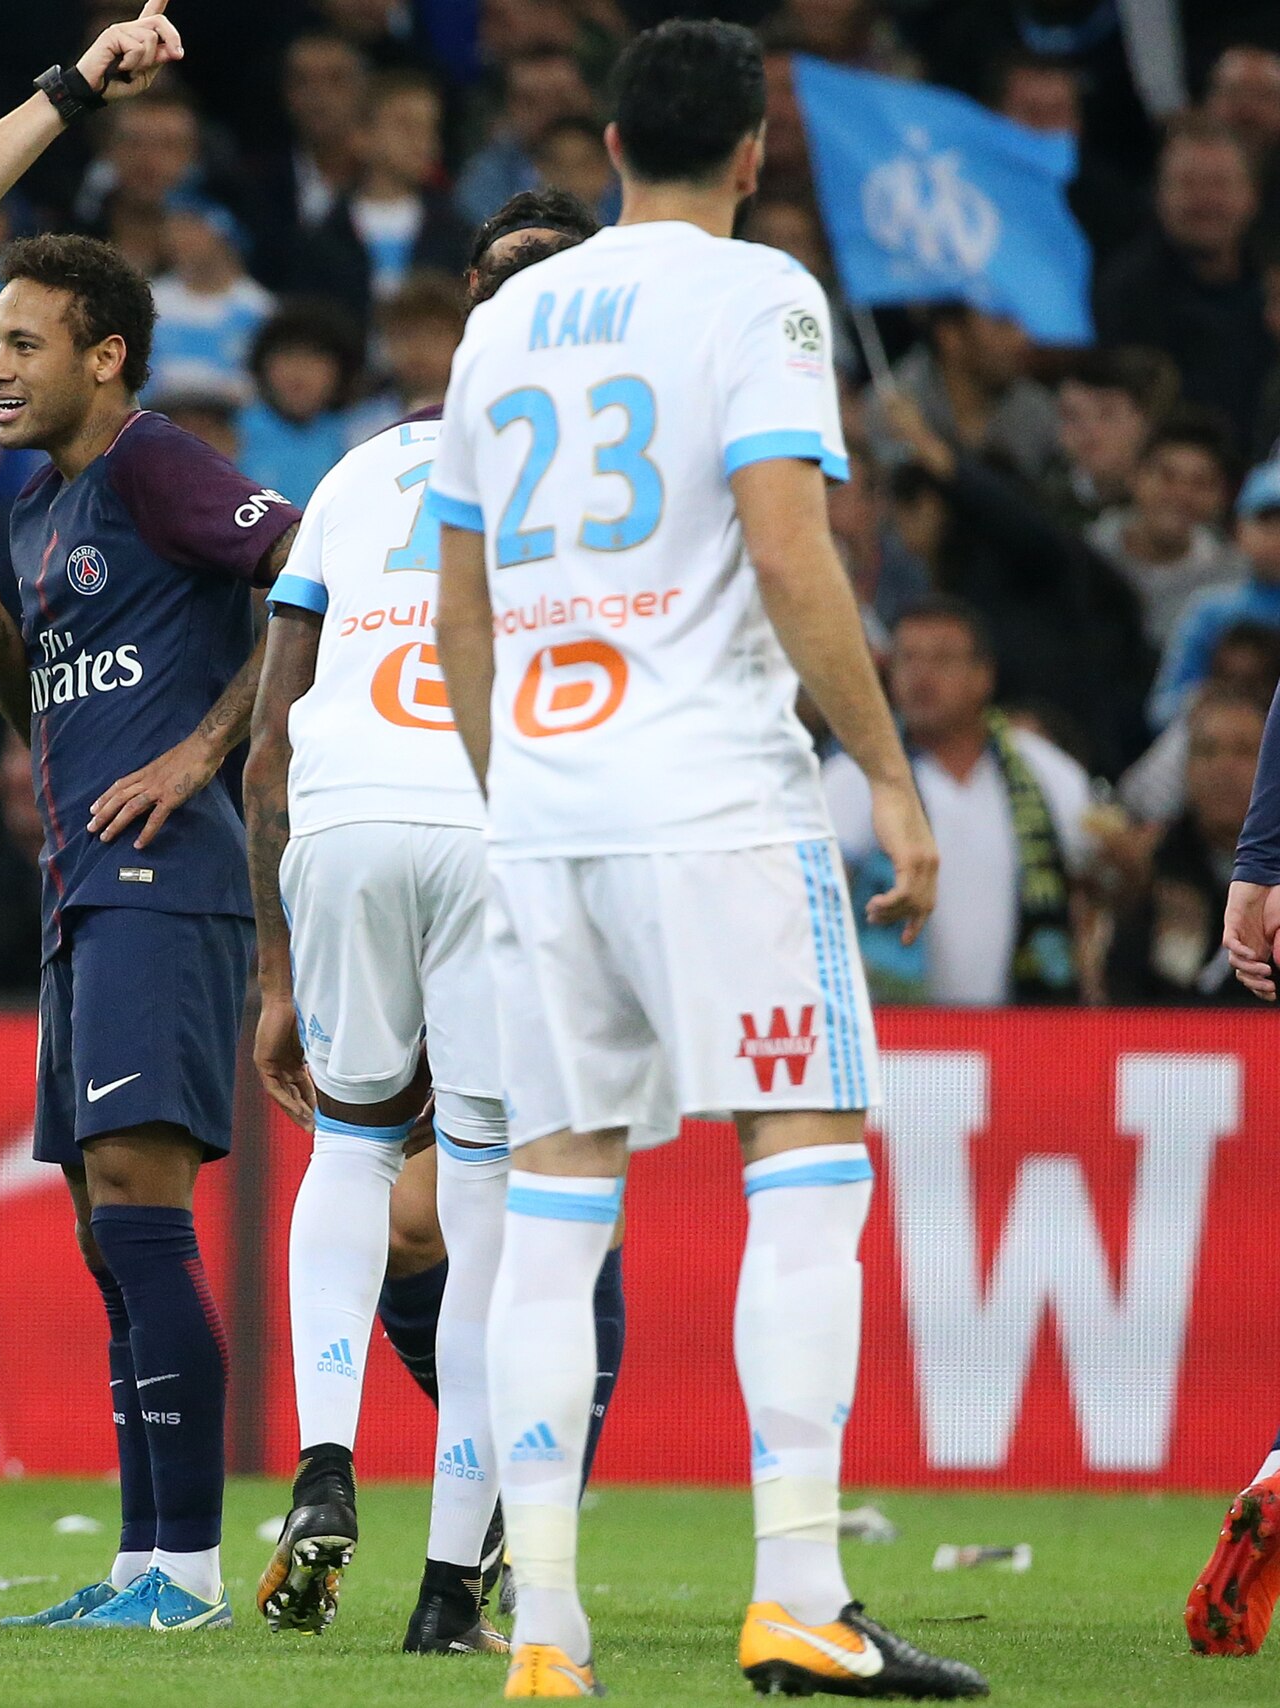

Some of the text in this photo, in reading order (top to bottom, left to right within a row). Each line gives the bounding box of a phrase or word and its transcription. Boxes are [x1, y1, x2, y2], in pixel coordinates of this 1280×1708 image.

[528, 282, 641, 351] RAMI
[486, 374, 665, 569] 23
[234, 489, 292, 527] QNB
[71, 548, 96, 563] PARIS
[339, 600, 439, 637] oul
[868, 1050, 1245, 1472] W
[317, 1358, 357, 1380] adidas
[438, 1460, 486, 1482] adidas
